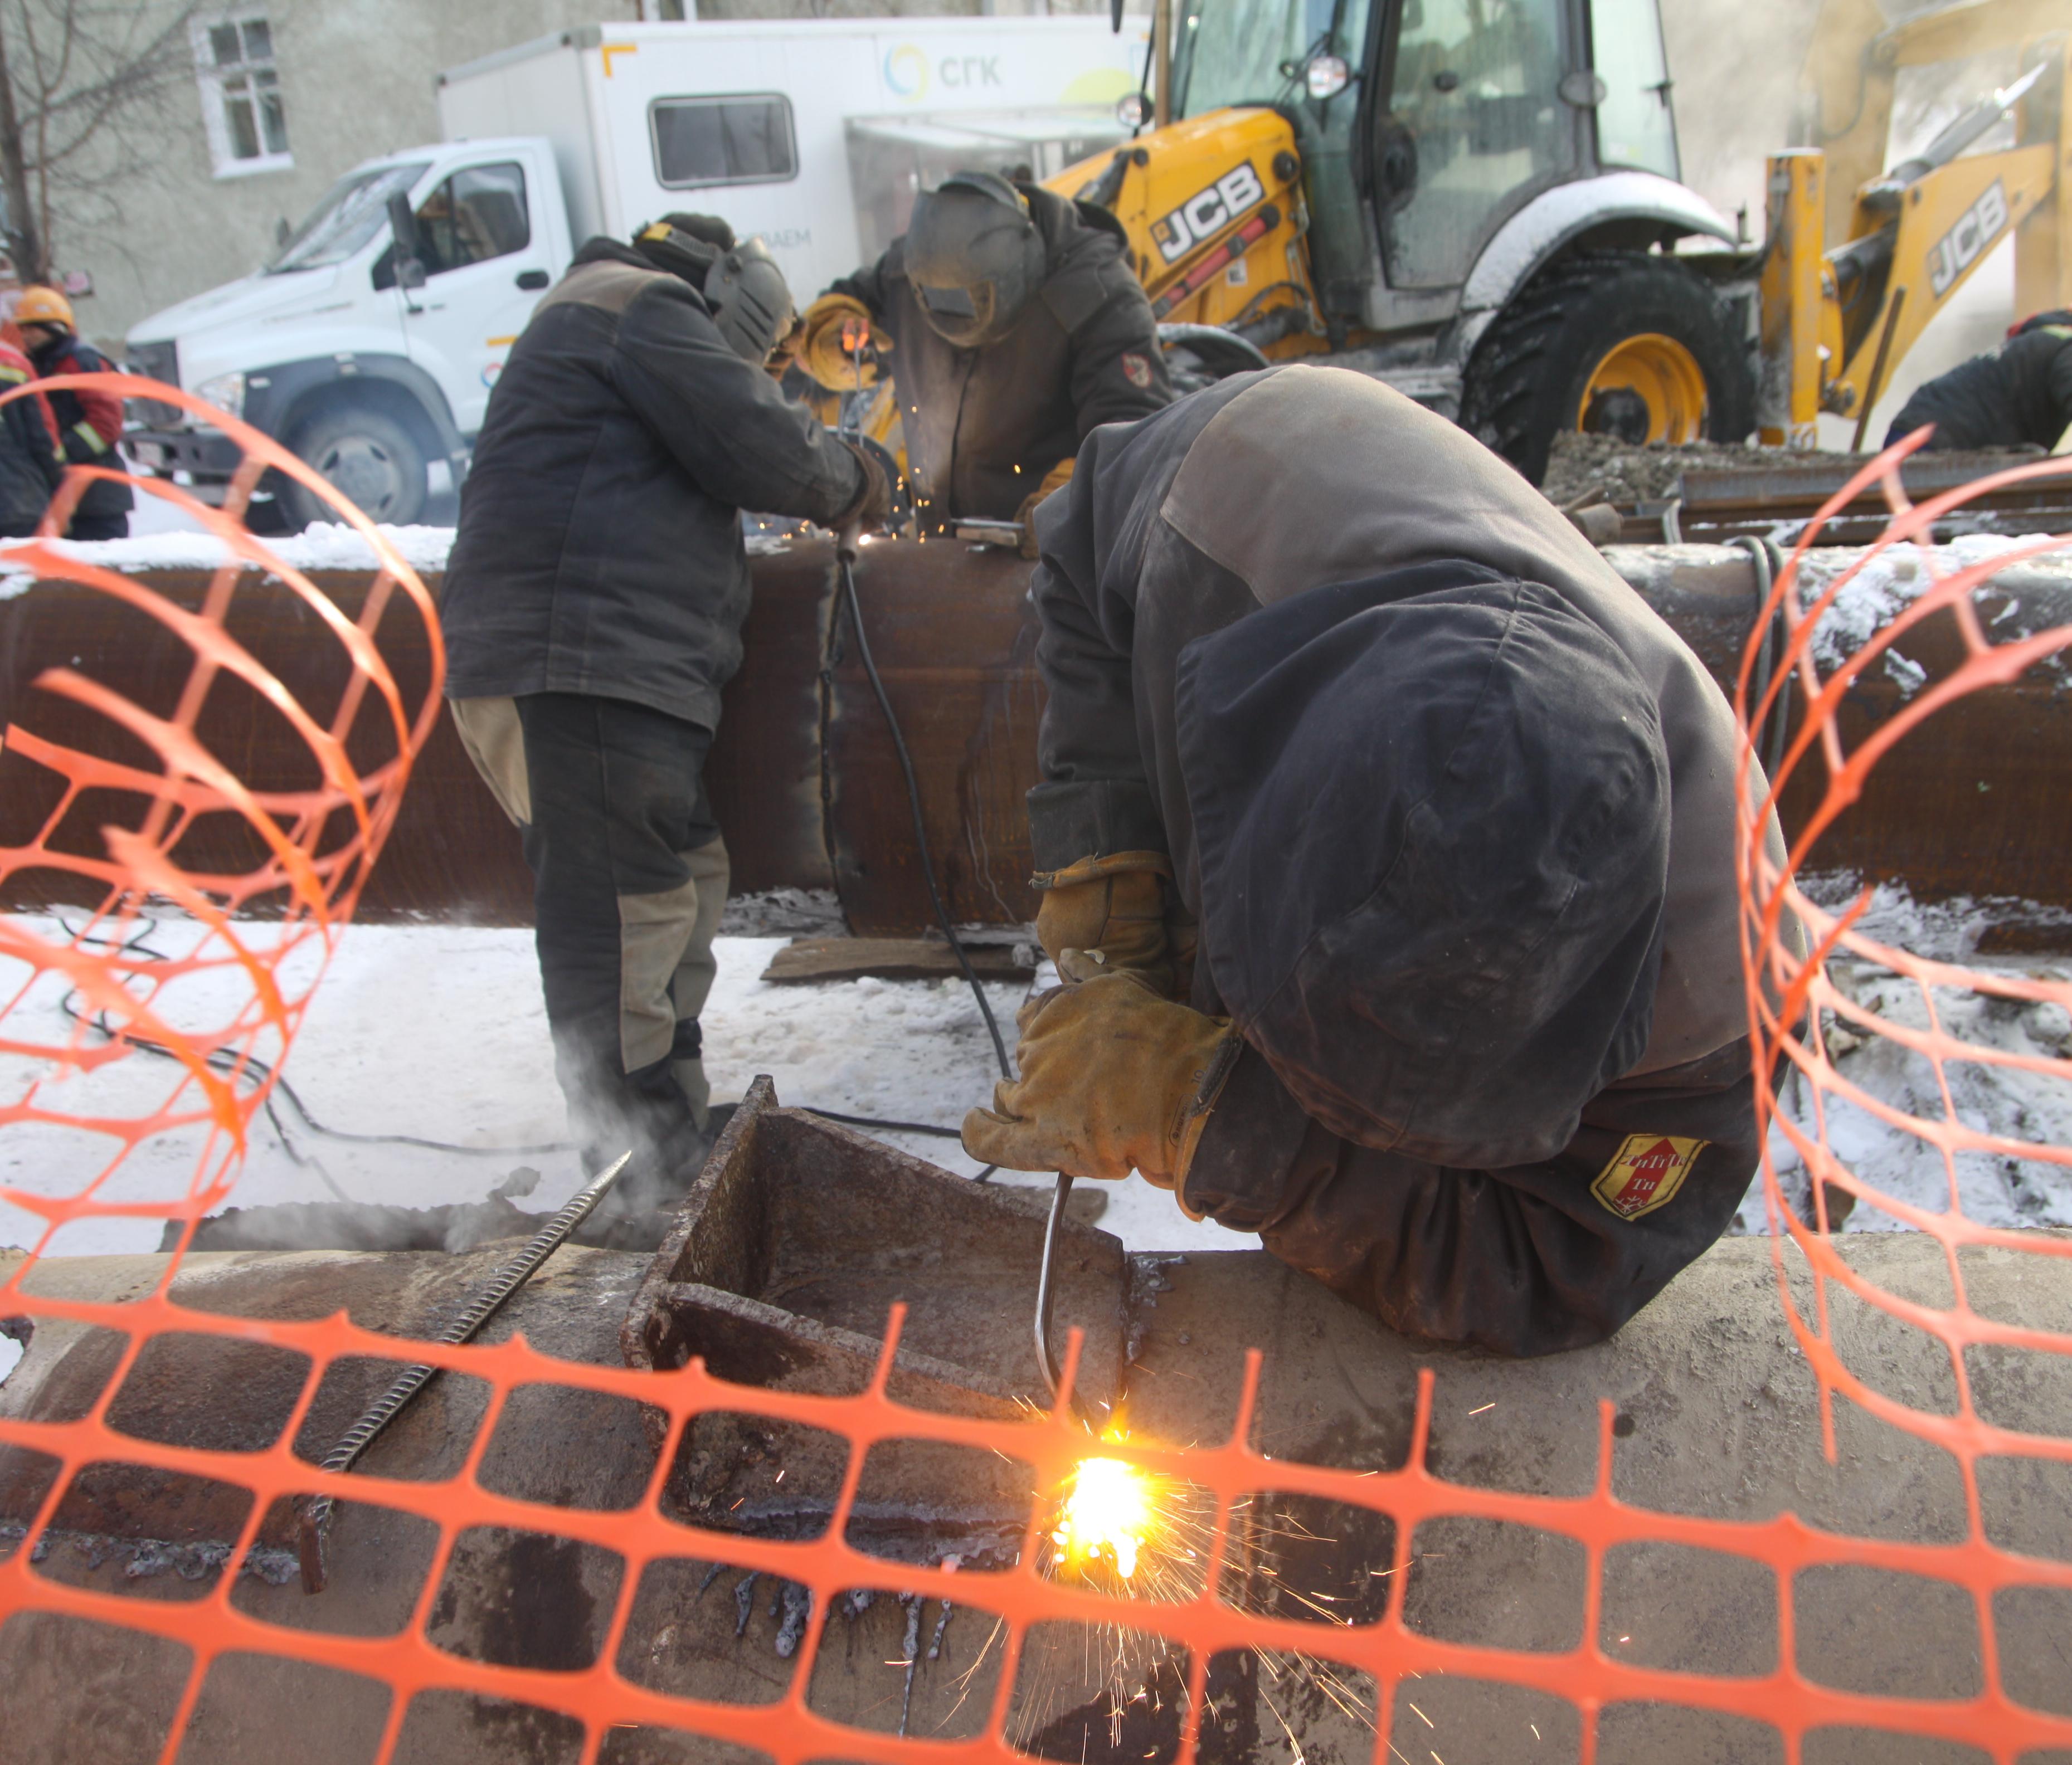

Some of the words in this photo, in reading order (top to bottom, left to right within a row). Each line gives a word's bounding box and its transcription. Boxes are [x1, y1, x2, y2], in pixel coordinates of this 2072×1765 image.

[940, 55, 1001, 87] СГК
[1160, 164, 1262, 260] JCB
[1932, 183, 2006, 294] JCB
[1191, 1069, 1205, 1084] 10
